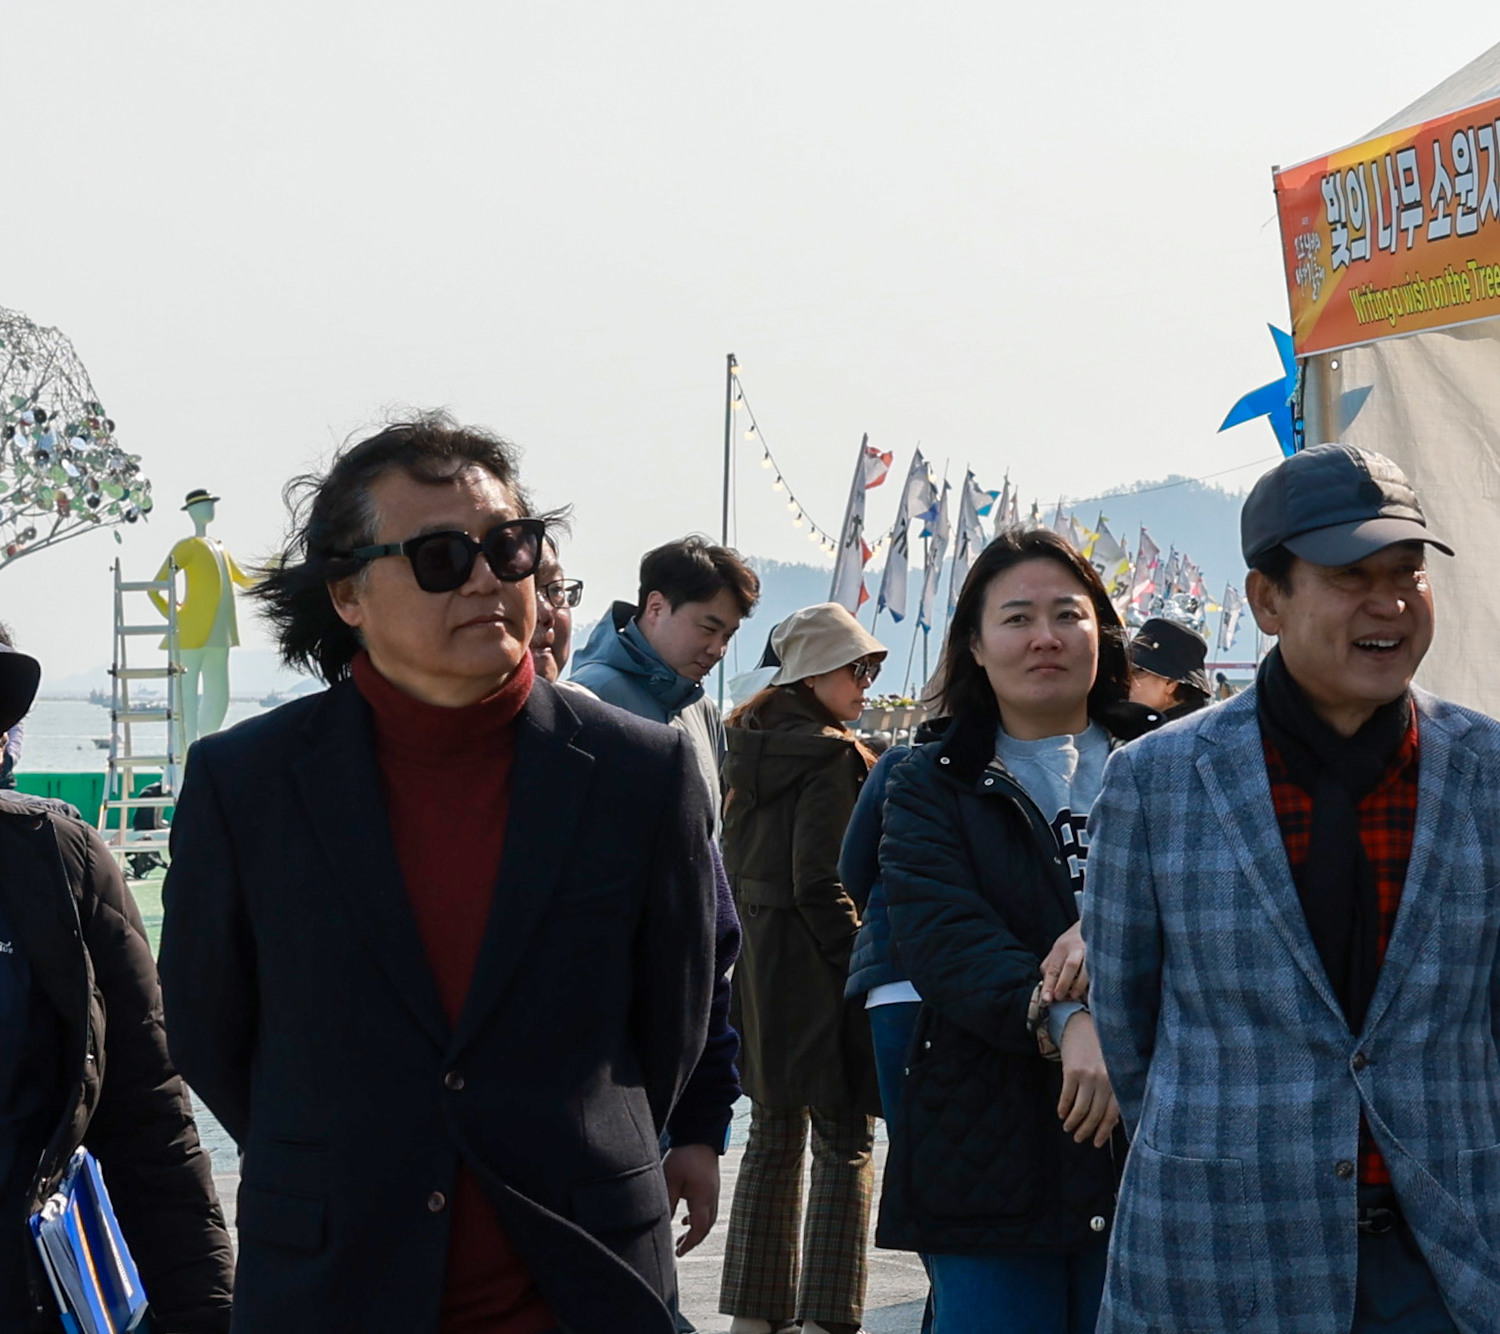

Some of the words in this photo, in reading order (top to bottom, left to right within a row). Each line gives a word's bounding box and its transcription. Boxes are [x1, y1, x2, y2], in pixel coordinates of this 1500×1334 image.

[1320, 161, 1371, 272] 빛의
[1371, 145, 1424, 255] 나무
[1349, 280, 1397, 328] Writing
[1401, 271, 1433, 316] wish
[1429, 273, 1450, 310] on
[1445, 264, 1471, 306] the
